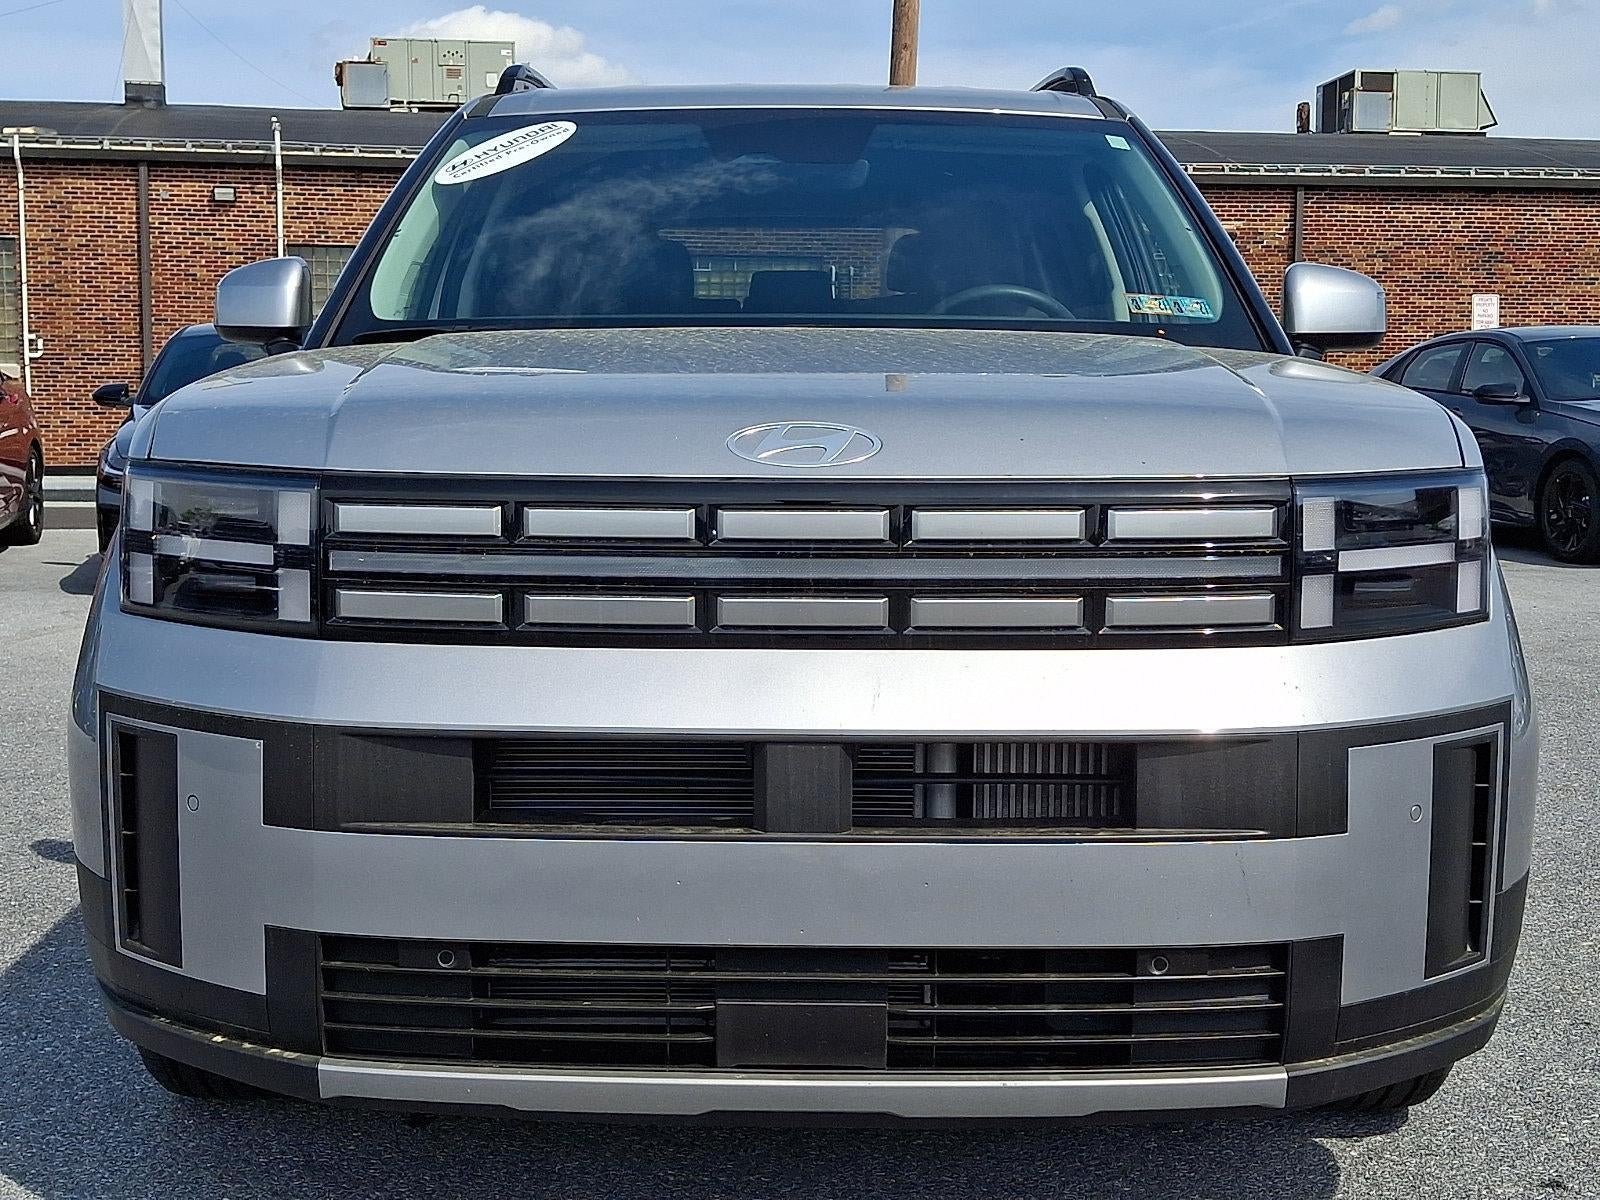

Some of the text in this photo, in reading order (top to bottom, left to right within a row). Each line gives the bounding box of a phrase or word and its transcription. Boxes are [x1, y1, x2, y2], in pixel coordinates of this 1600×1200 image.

[453, 127, 570, 179] Certified Pre-Owned
[474, 123, 559, 159] HYUNDAI
